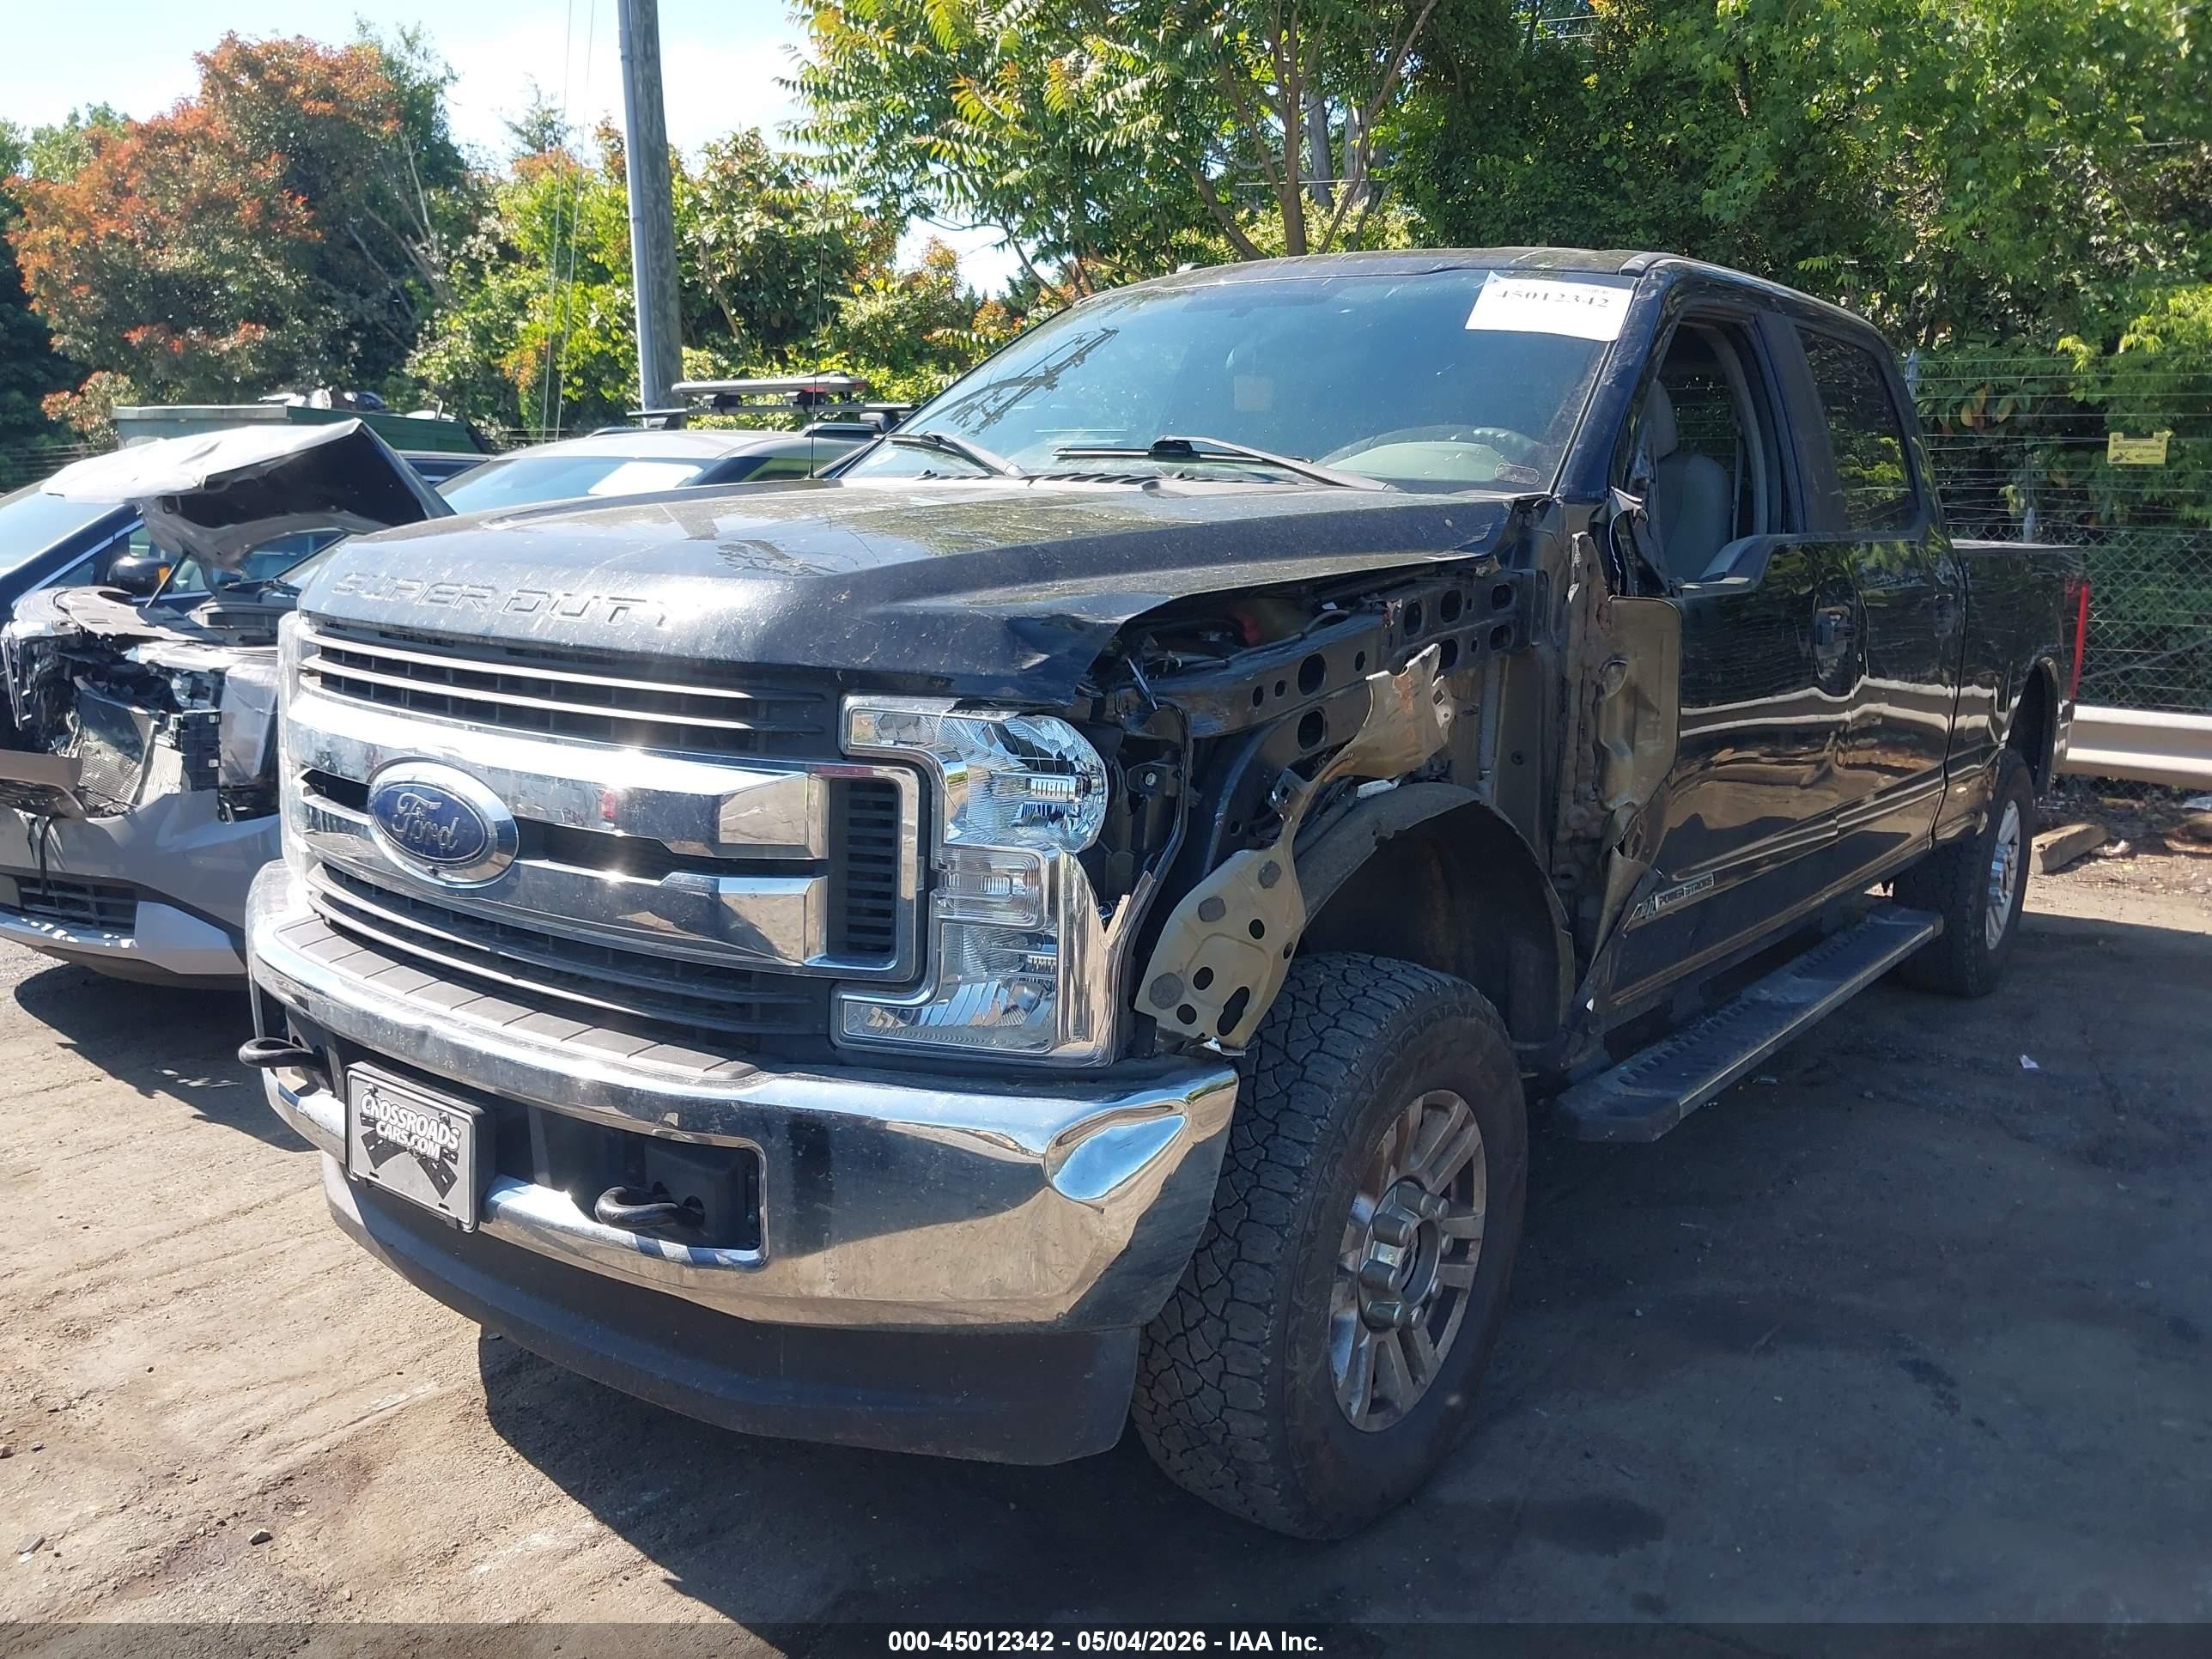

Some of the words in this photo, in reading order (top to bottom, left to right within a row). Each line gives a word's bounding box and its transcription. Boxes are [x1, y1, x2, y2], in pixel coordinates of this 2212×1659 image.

[1497, 289, 1609, 307] 45012342
[331, 571, 498, 612] SUPER
[392, 792, 460, 850] Ford
[375, 1119, 441, 1161] CARS.COM
